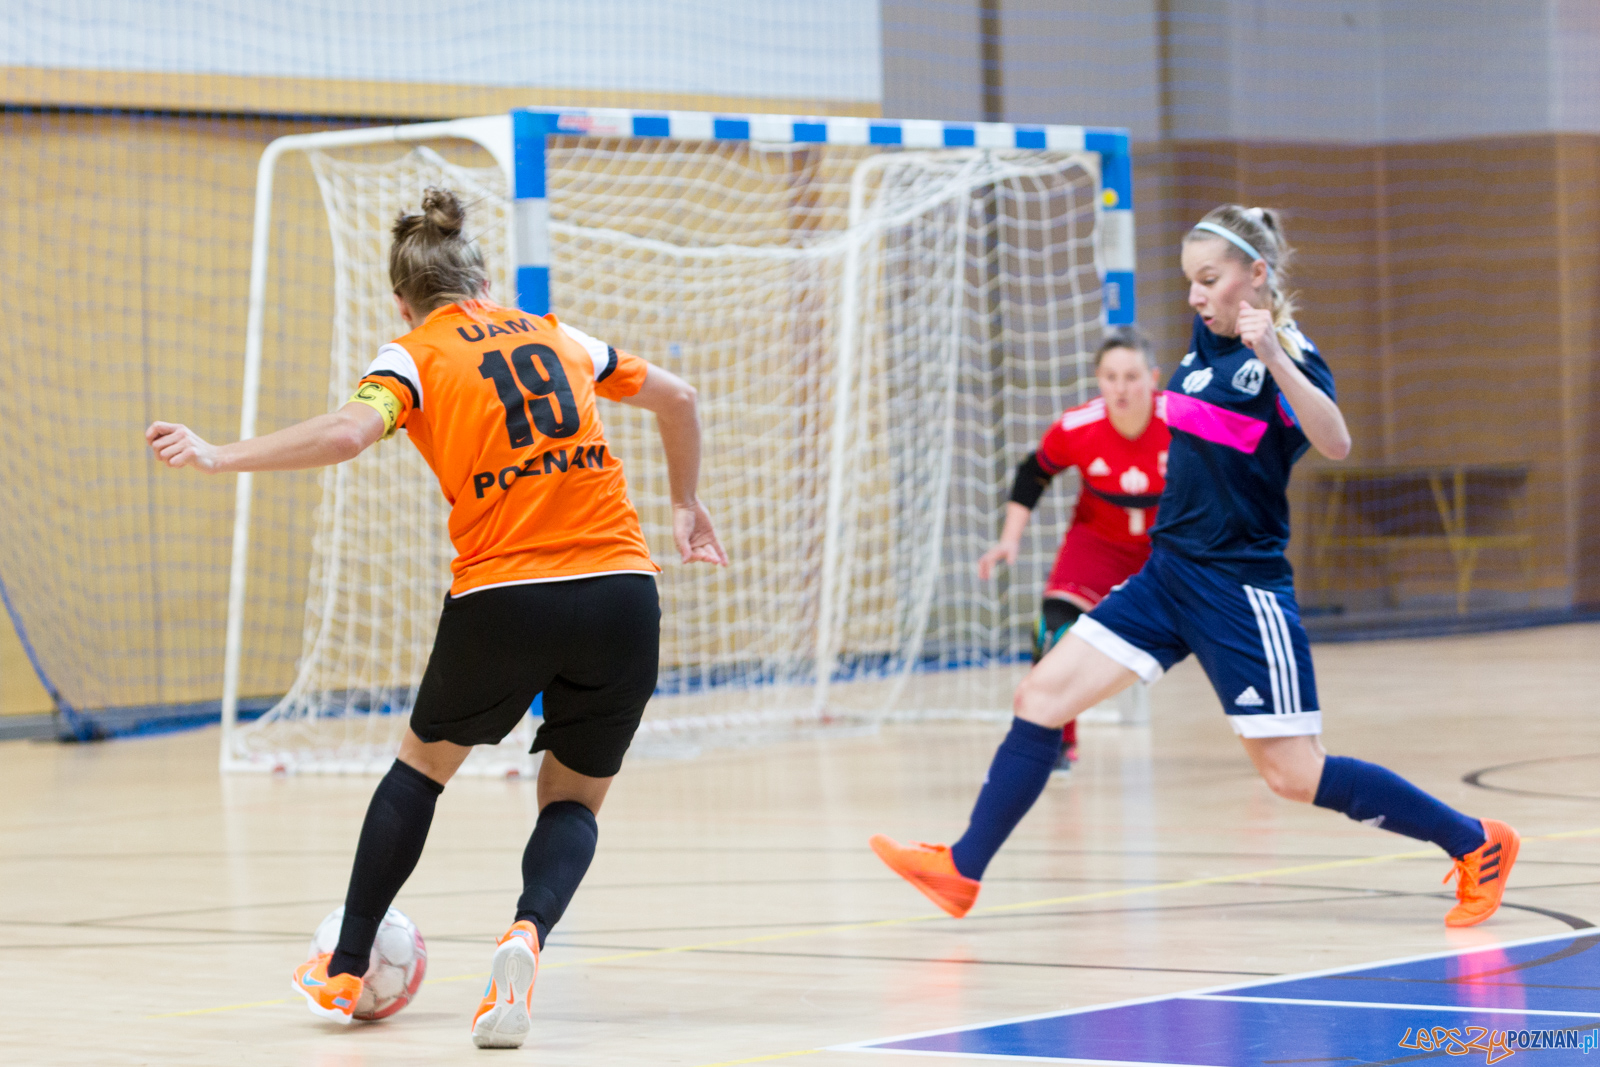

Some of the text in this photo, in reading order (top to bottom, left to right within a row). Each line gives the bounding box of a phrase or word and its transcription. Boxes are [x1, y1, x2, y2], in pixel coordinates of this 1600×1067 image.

[456, 317, 538, 342] UAM
[354, 383, 384, 401] C
[477, 342, 581, 449] 19
